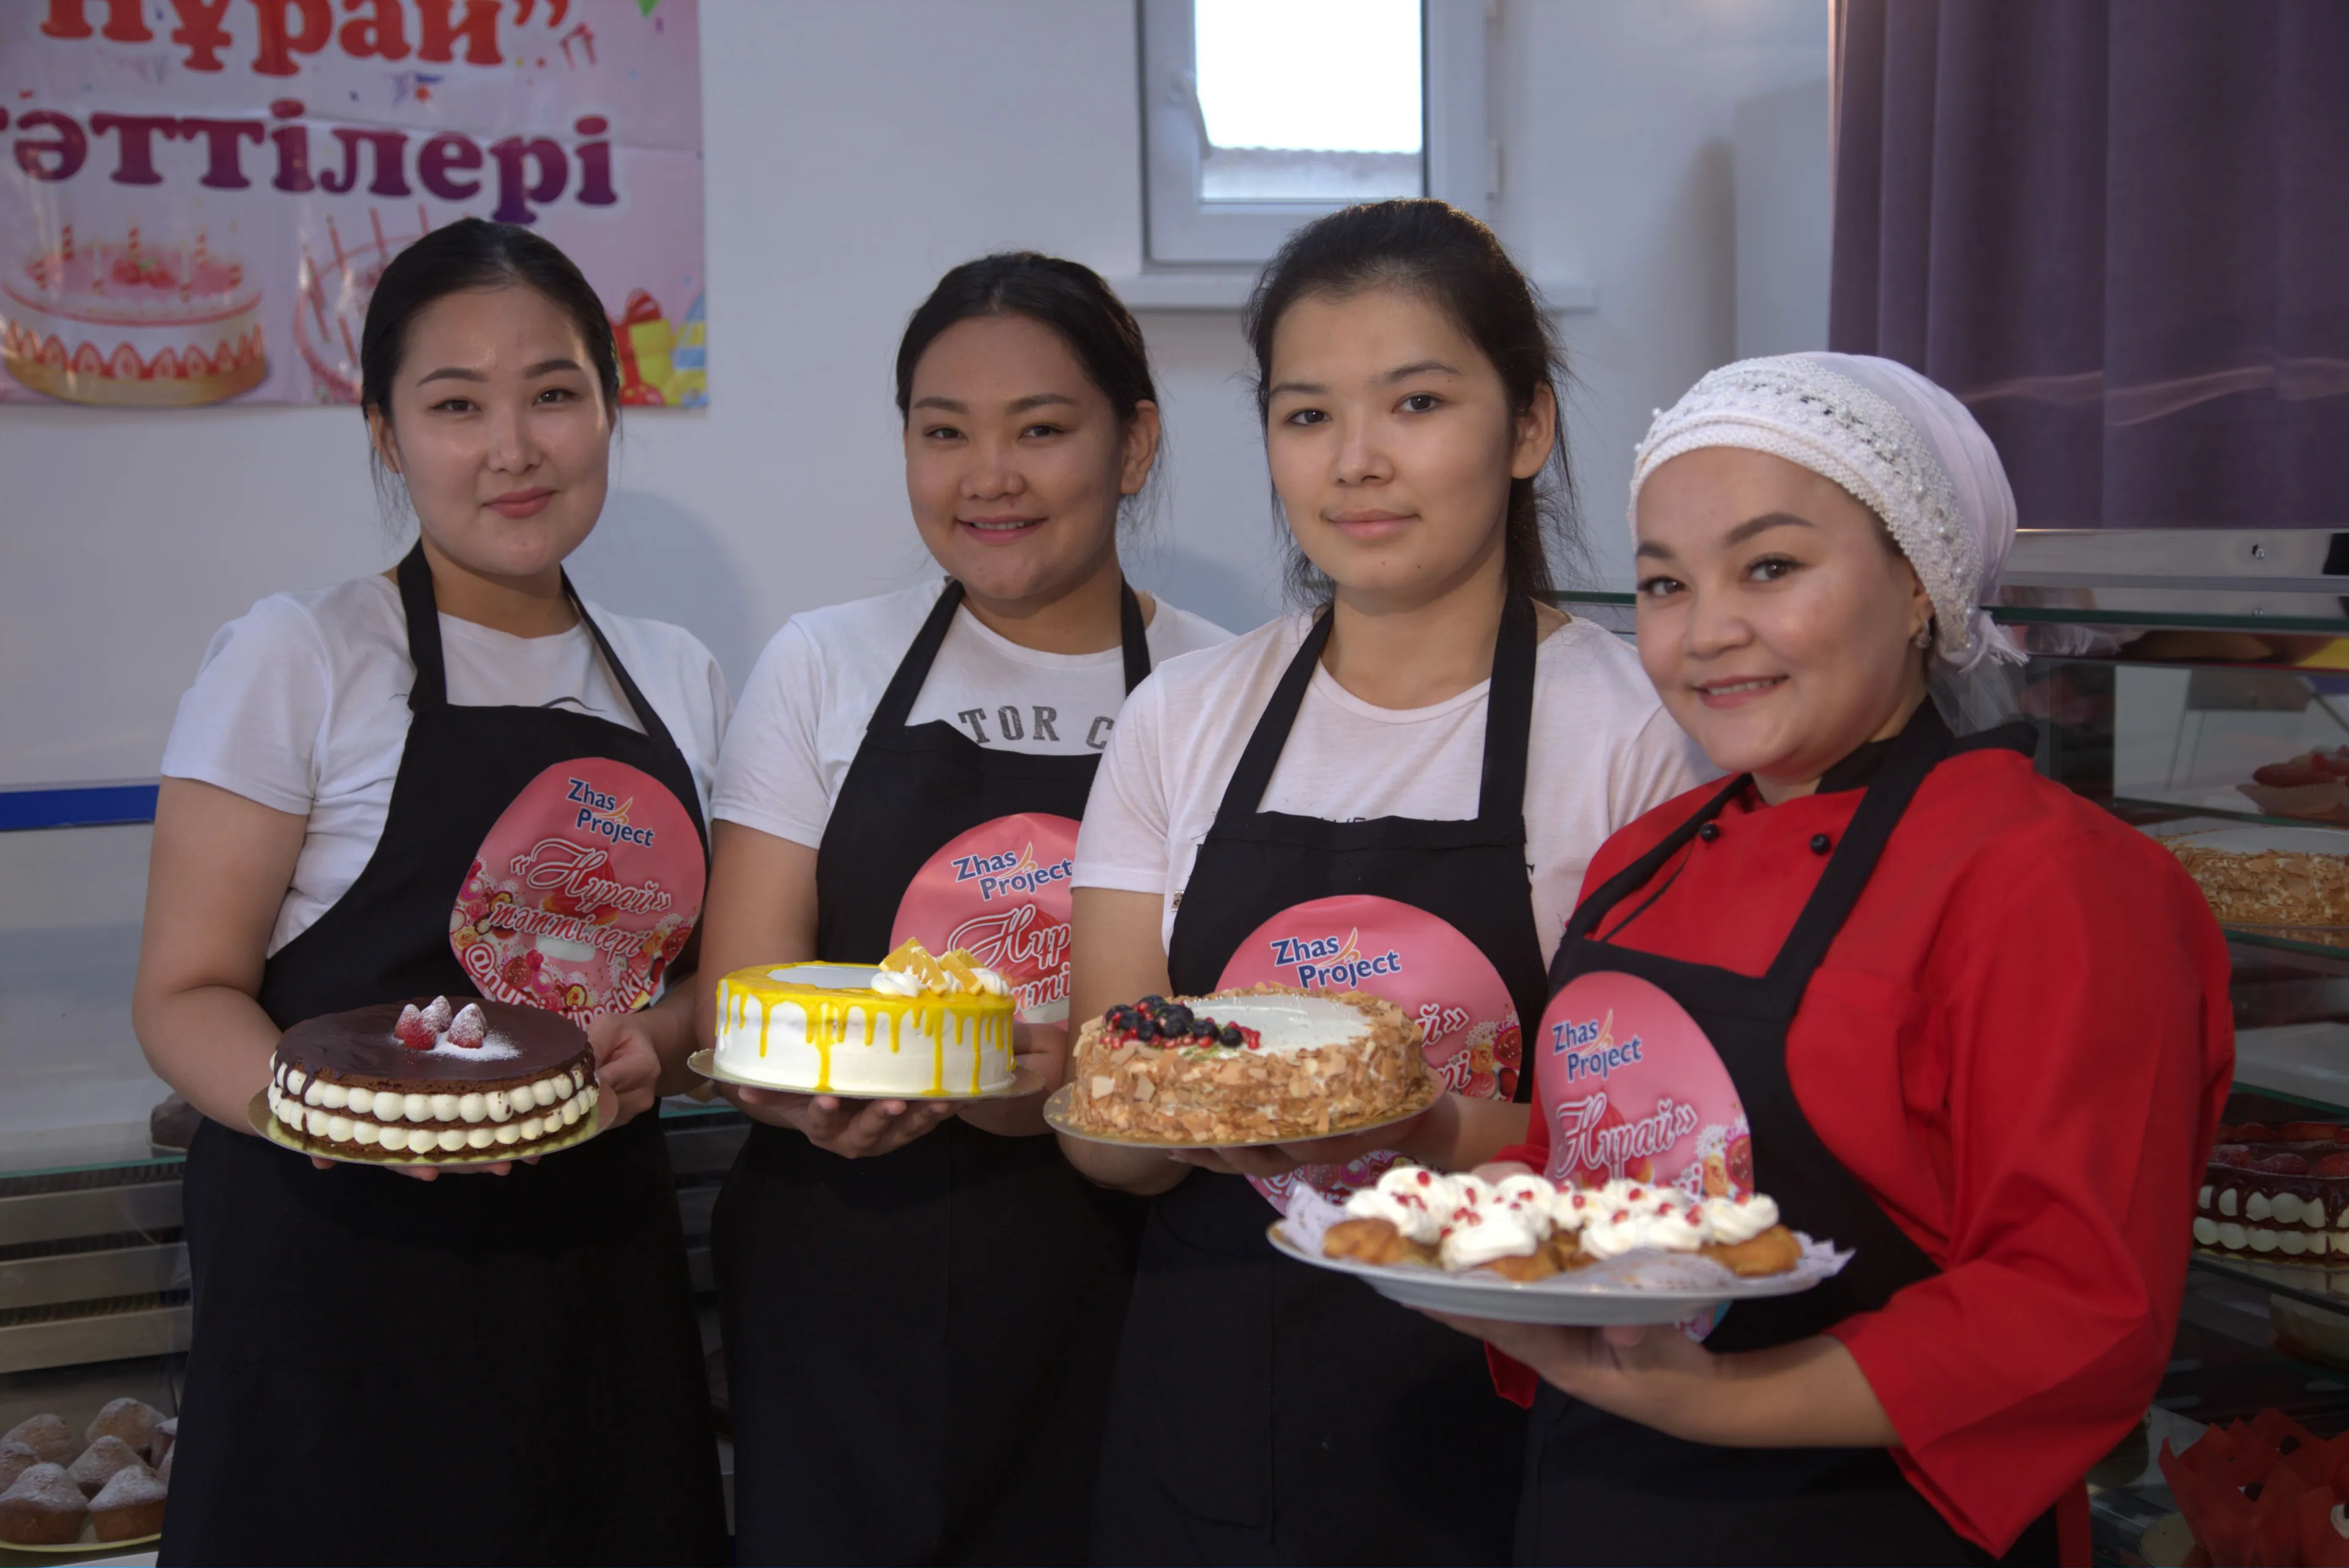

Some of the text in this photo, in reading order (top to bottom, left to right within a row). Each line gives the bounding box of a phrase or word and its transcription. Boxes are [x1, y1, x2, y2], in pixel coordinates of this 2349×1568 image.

[0, 99, 618, 224] әттілері
[957, 706, 1060, 744] TOR
[566, 777, 616, 812] Zhas
[576, 807, 655, 848] Project
[951, 851, 1017, 882] Zhas
[979, 857, 1072, 901] Project
[1271, 936, 1340, 966] Zhas
[1297, 949, 1401, 989] Project
[1553, 1019, 1598, 1055] Zhas
[1567, 1032, 1642, 1084] Project
